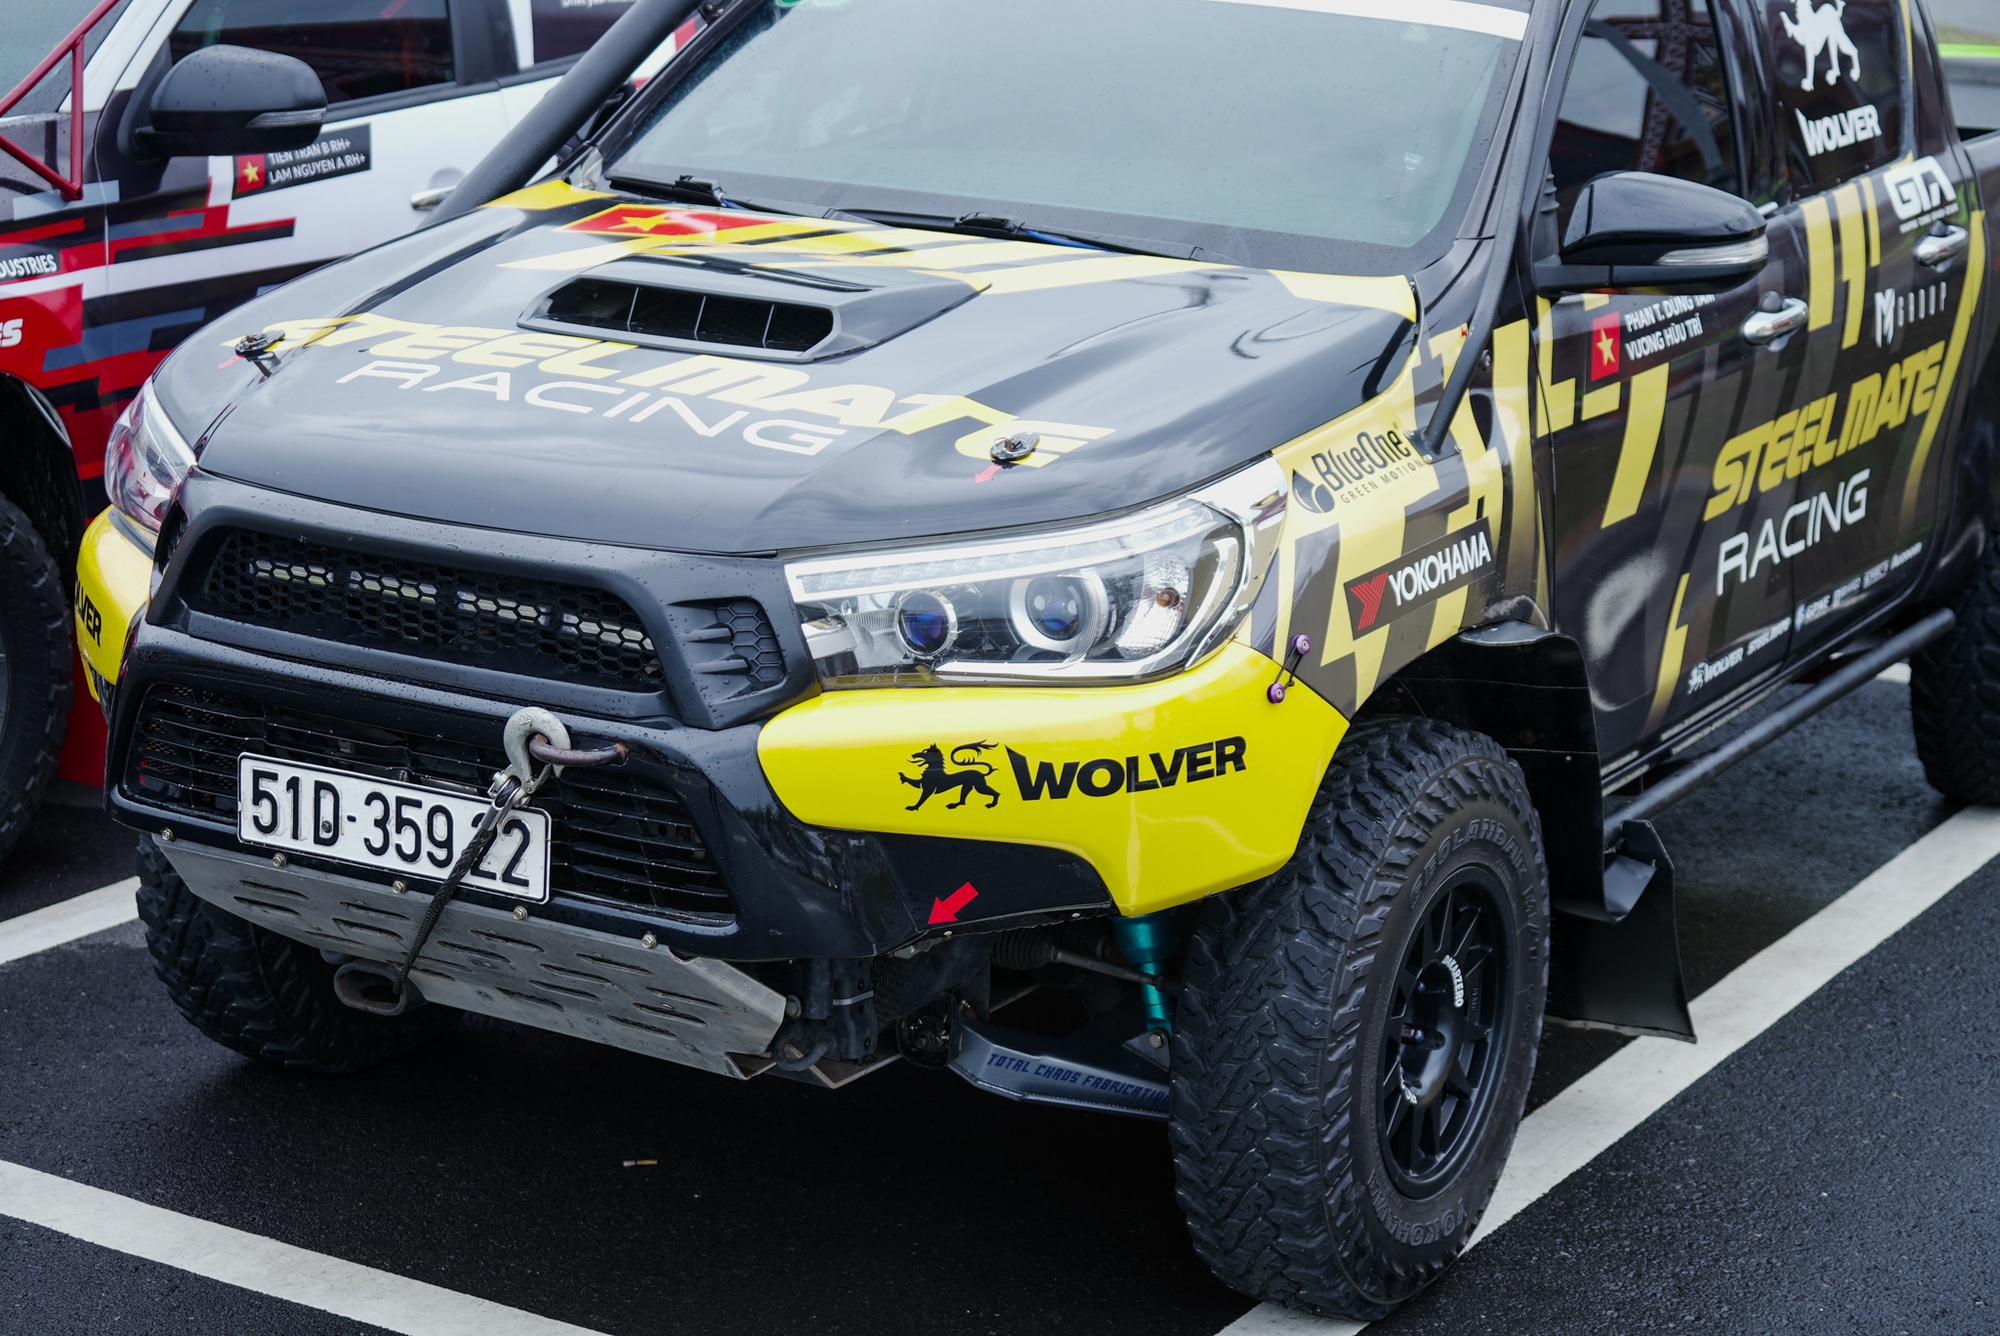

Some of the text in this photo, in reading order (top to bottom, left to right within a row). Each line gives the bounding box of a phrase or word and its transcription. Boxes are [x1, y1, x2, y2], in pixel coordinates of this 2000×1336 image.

[322, 141, 331, 155] B
[331, 138, 351, 153] RH+
[1795, 104, 1882, 157] WOLVER
[268, 153, 366, 185] LAM NGUYEN A RH+
[1624, 306, 1656, 333] PHAN
[220, 313, 1116, 468] STEELMATE
[335, 360, 847, 456] RACING
[1703, 340, 1945, 522] STEELMATE
[1340, 458, 1424, 503] GREEN MOTION
[1717, 468, 1870, 596] RACING
[1388, 531, 1491, 607] YOKOHAMA
[1704, 646, 1744, 684] WOLVER
[1004, 735, 1247, 801] WOLVER
[1410, 818, 1528, 910] GEOLANDAR
[1441, 954, 1465, 1008] DAKARZERO
[987, 1053, 1031, 1073] TOTAL
[1033, 1064, 1083, 1084] CHAOS
[1367, 1169, 1468, 1247] YOKOHAMA
